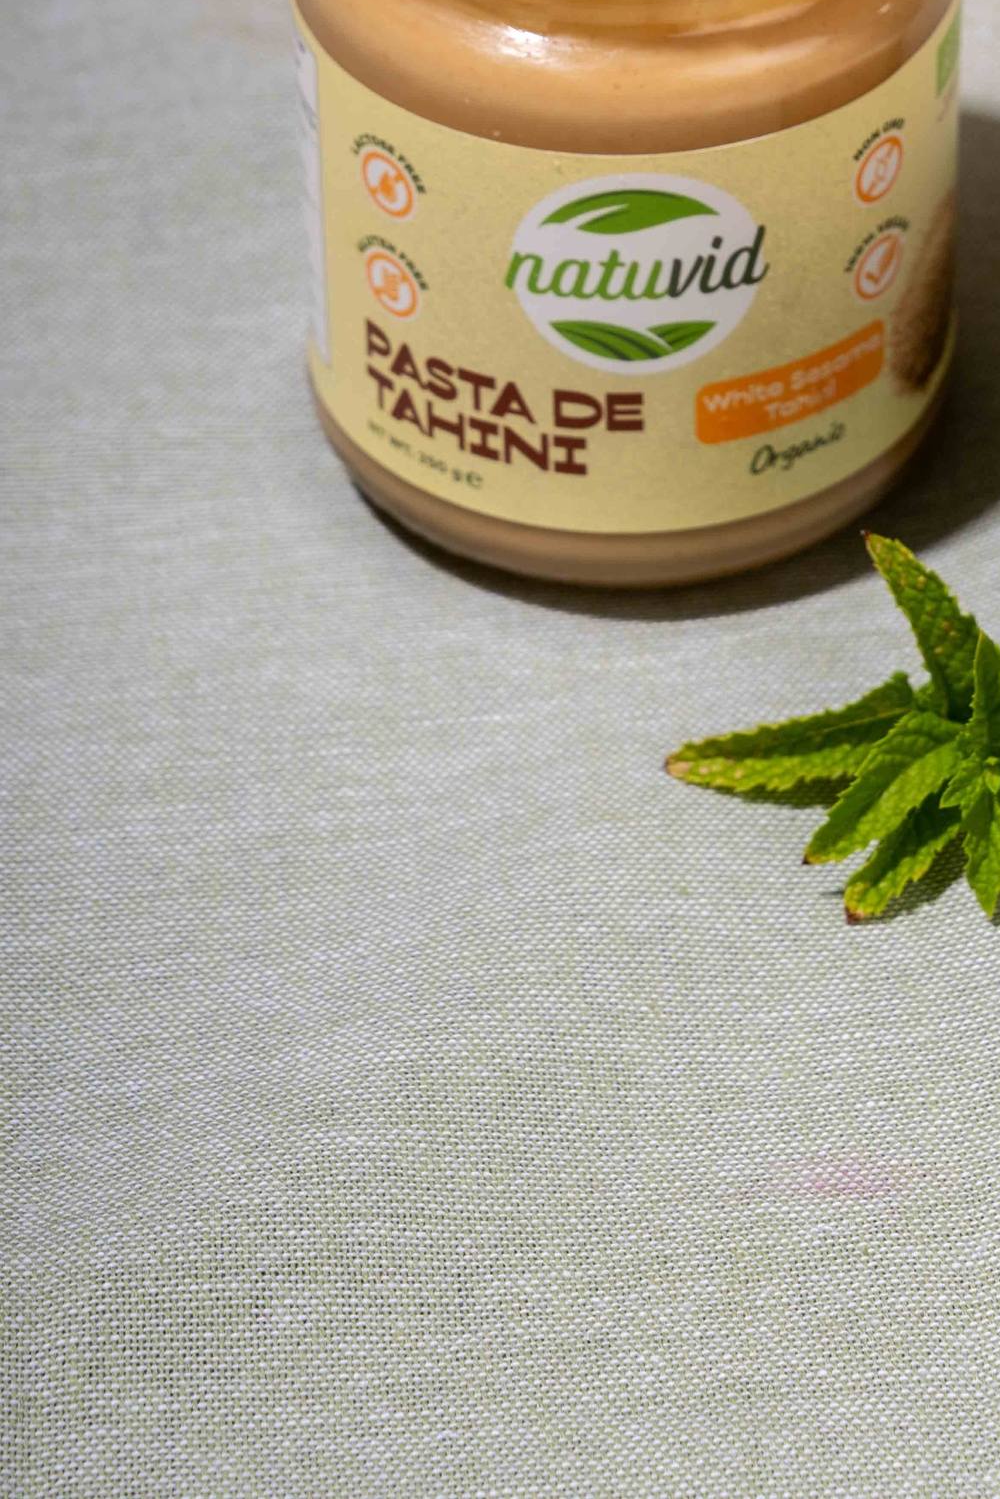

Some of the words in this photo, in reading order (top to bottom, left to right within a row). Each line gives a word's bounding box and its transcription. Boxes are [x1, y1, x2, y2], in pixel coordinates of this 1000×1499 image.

[504, 224, 770, 301] natuvid
[365, 317, 538, 424] PASTA
[552, 388, 645, 432] DE
[703, 380, 785, 413] White
[366, 364, 588, 477] TAHINI
[749, 421, 847, 476] Organic
